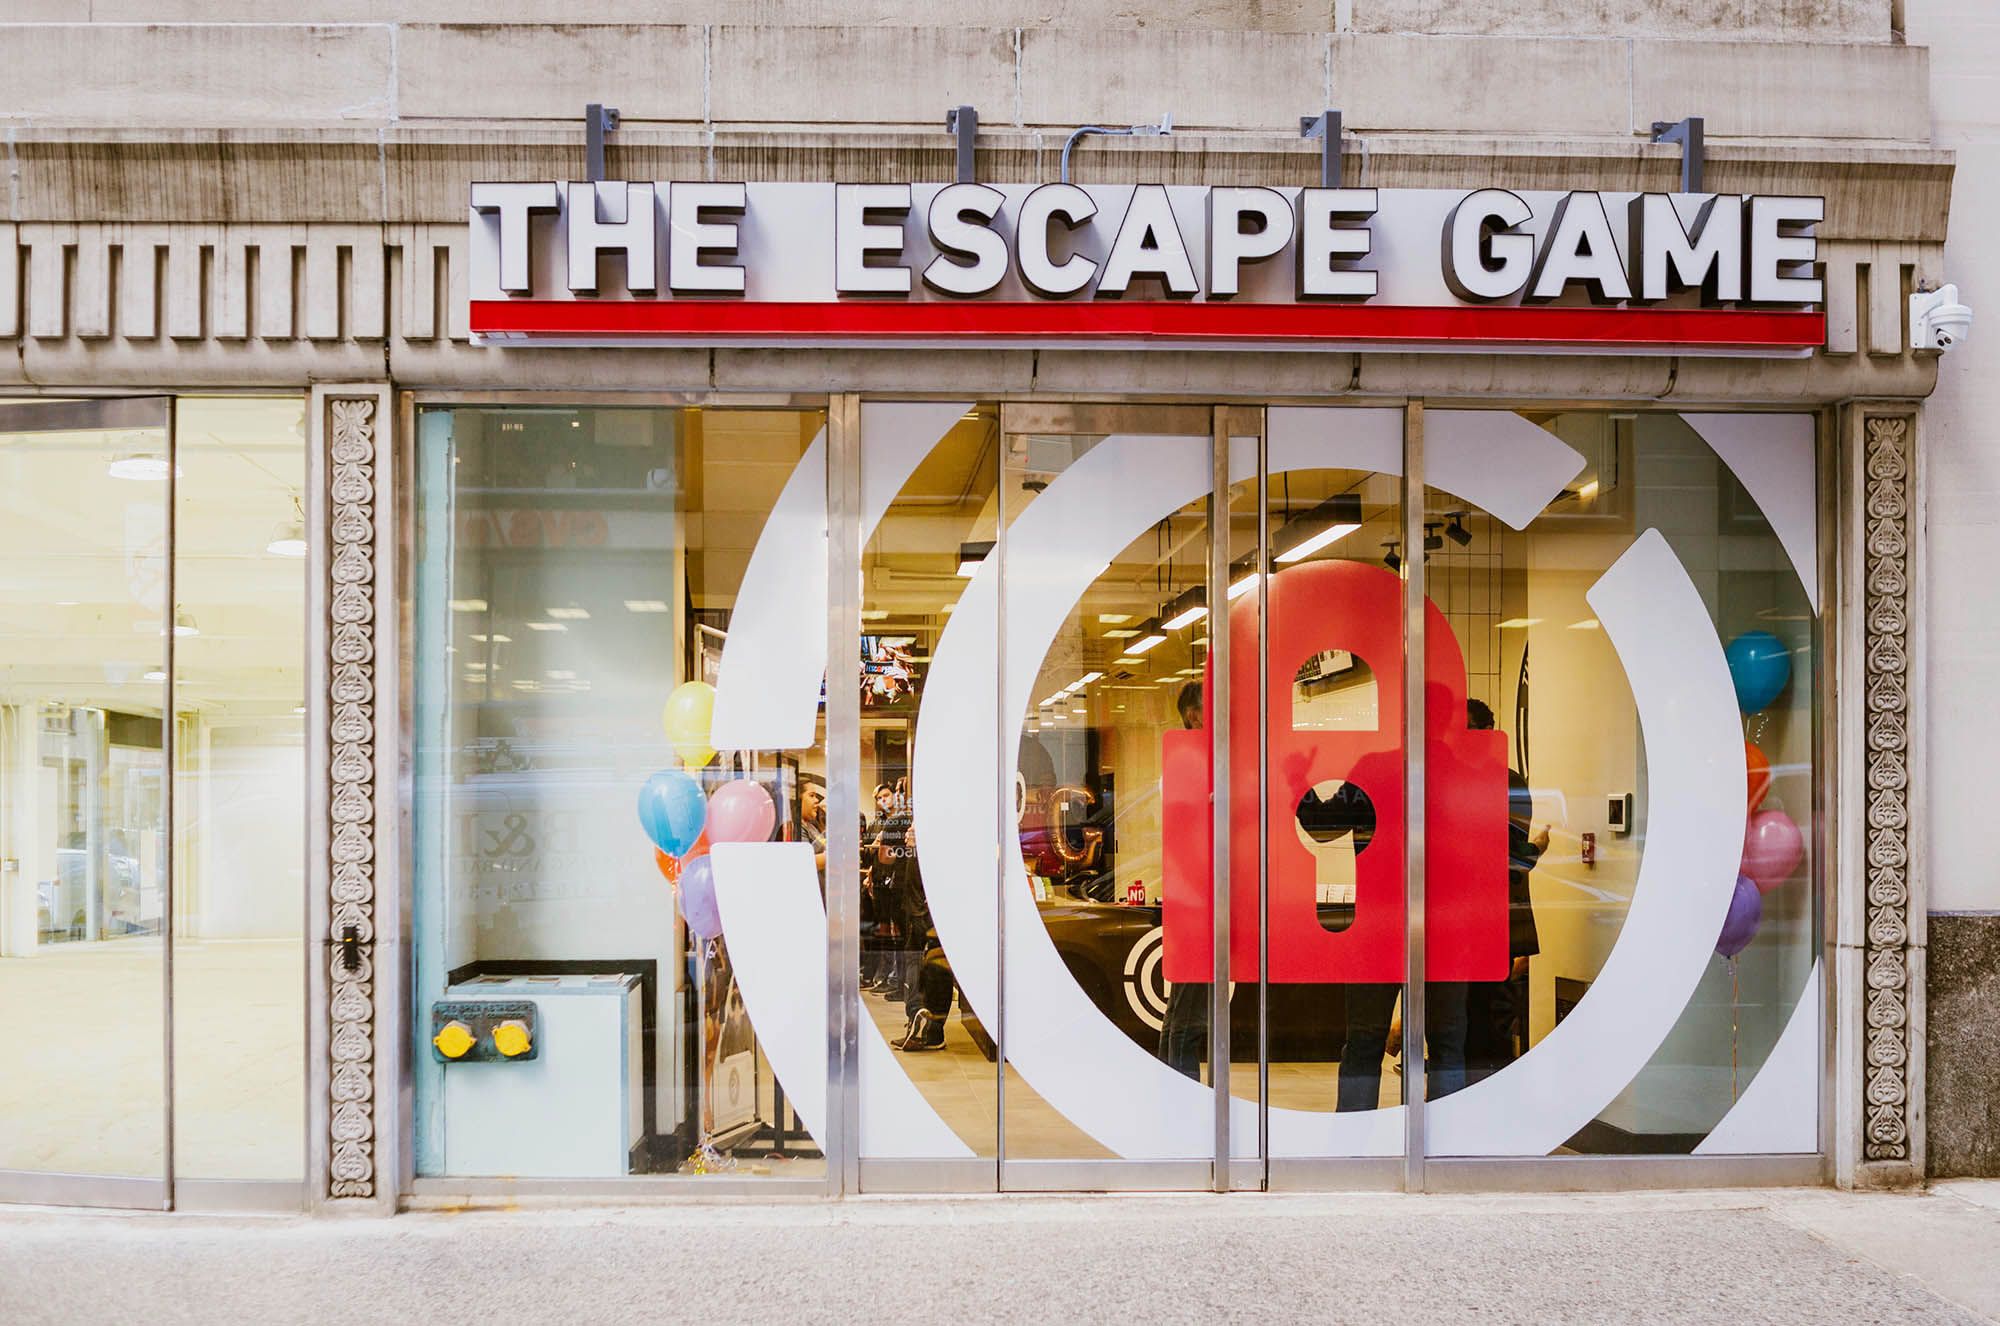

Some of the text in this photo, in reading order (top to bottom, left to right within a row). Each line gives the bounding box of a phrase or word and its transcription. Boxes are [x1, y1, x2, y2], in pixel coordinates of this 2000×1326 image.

[470, 181, 1826, 305] THE ESCAPE GAME
